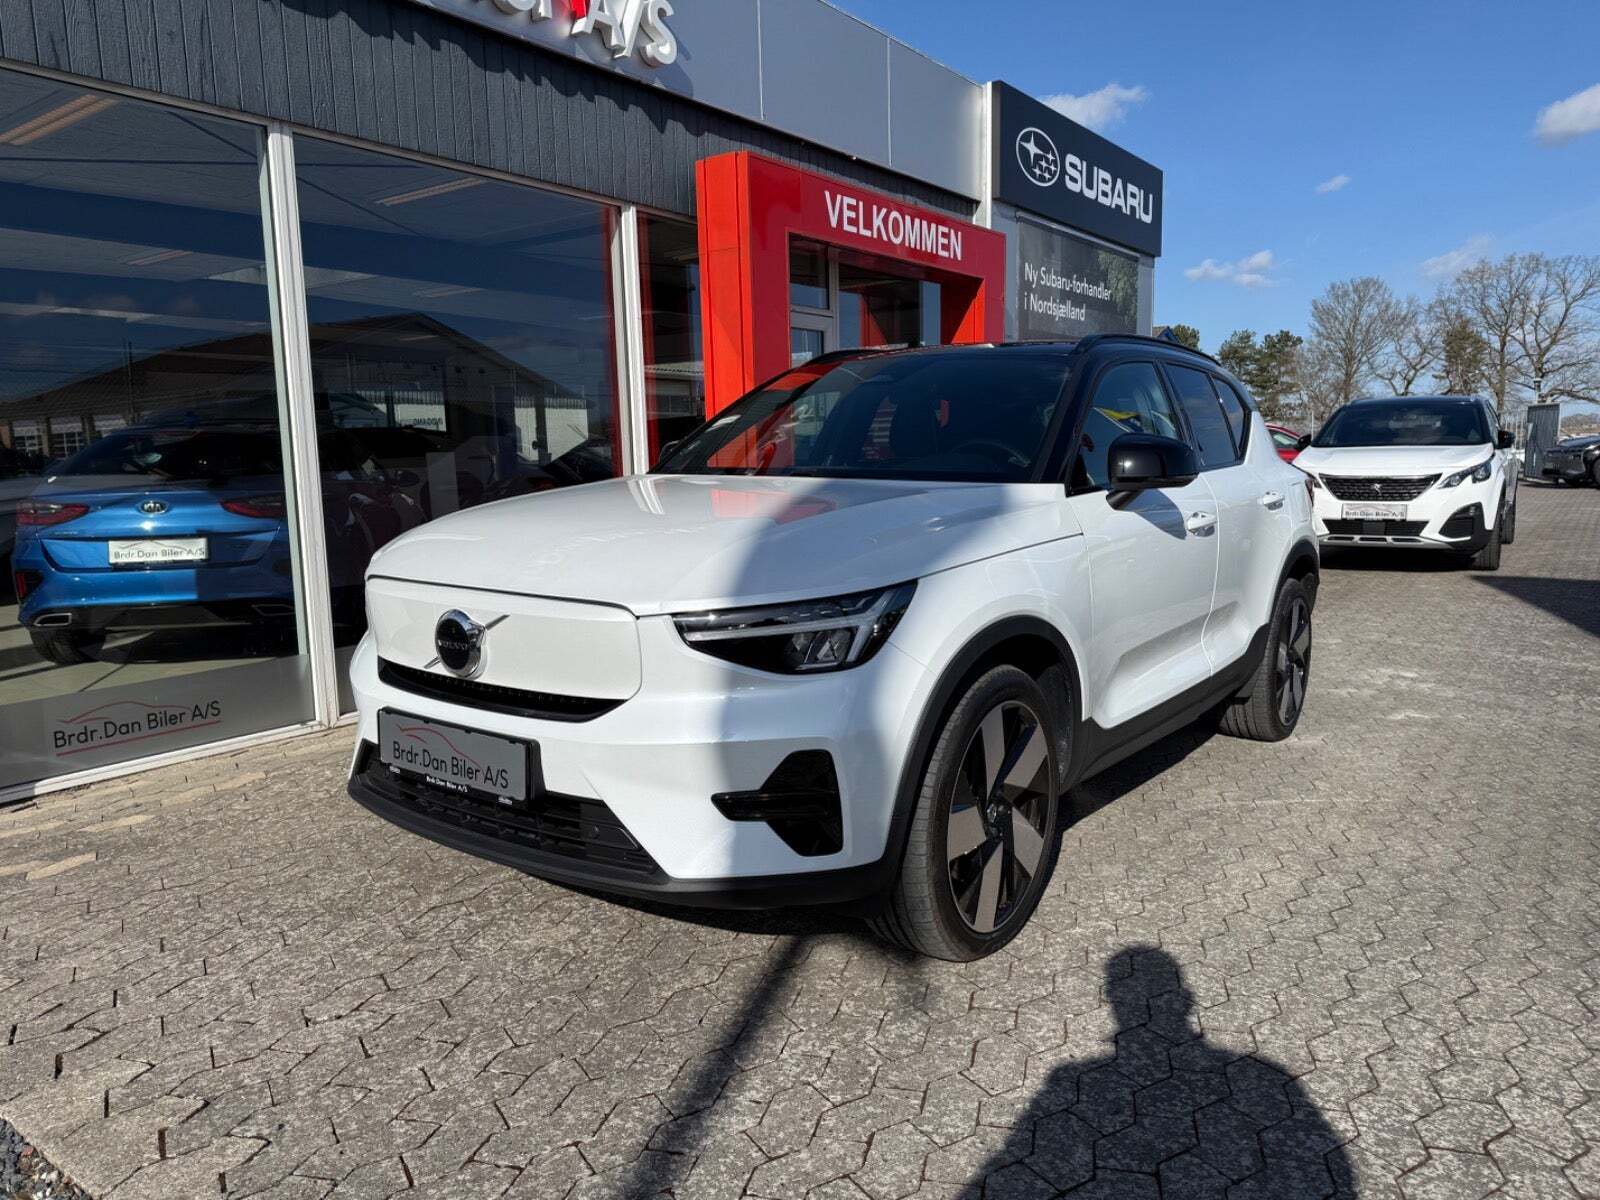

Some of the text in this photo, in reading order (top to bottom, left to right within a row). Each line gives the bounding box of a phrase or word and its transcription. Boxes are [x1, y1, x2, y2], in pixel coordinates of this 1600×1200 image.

[1065, 153, 1153, 224] SUBARU
[824, 190, 962, 261] VELKOMMEN
[1024, 262, 1112, 300] Ny Subaru-forhandler
[1024, 291, 1086, 321] i Nordsjælland
[161, 548, 184, 558] Biler
[187, 547, 205, 556] A/S
[147, 710, 186, 730] Biler
[191, 700, 221, 722] A/S
[451, 756, 481, 781] Biler
[483, 766, 509, 789] A/S
